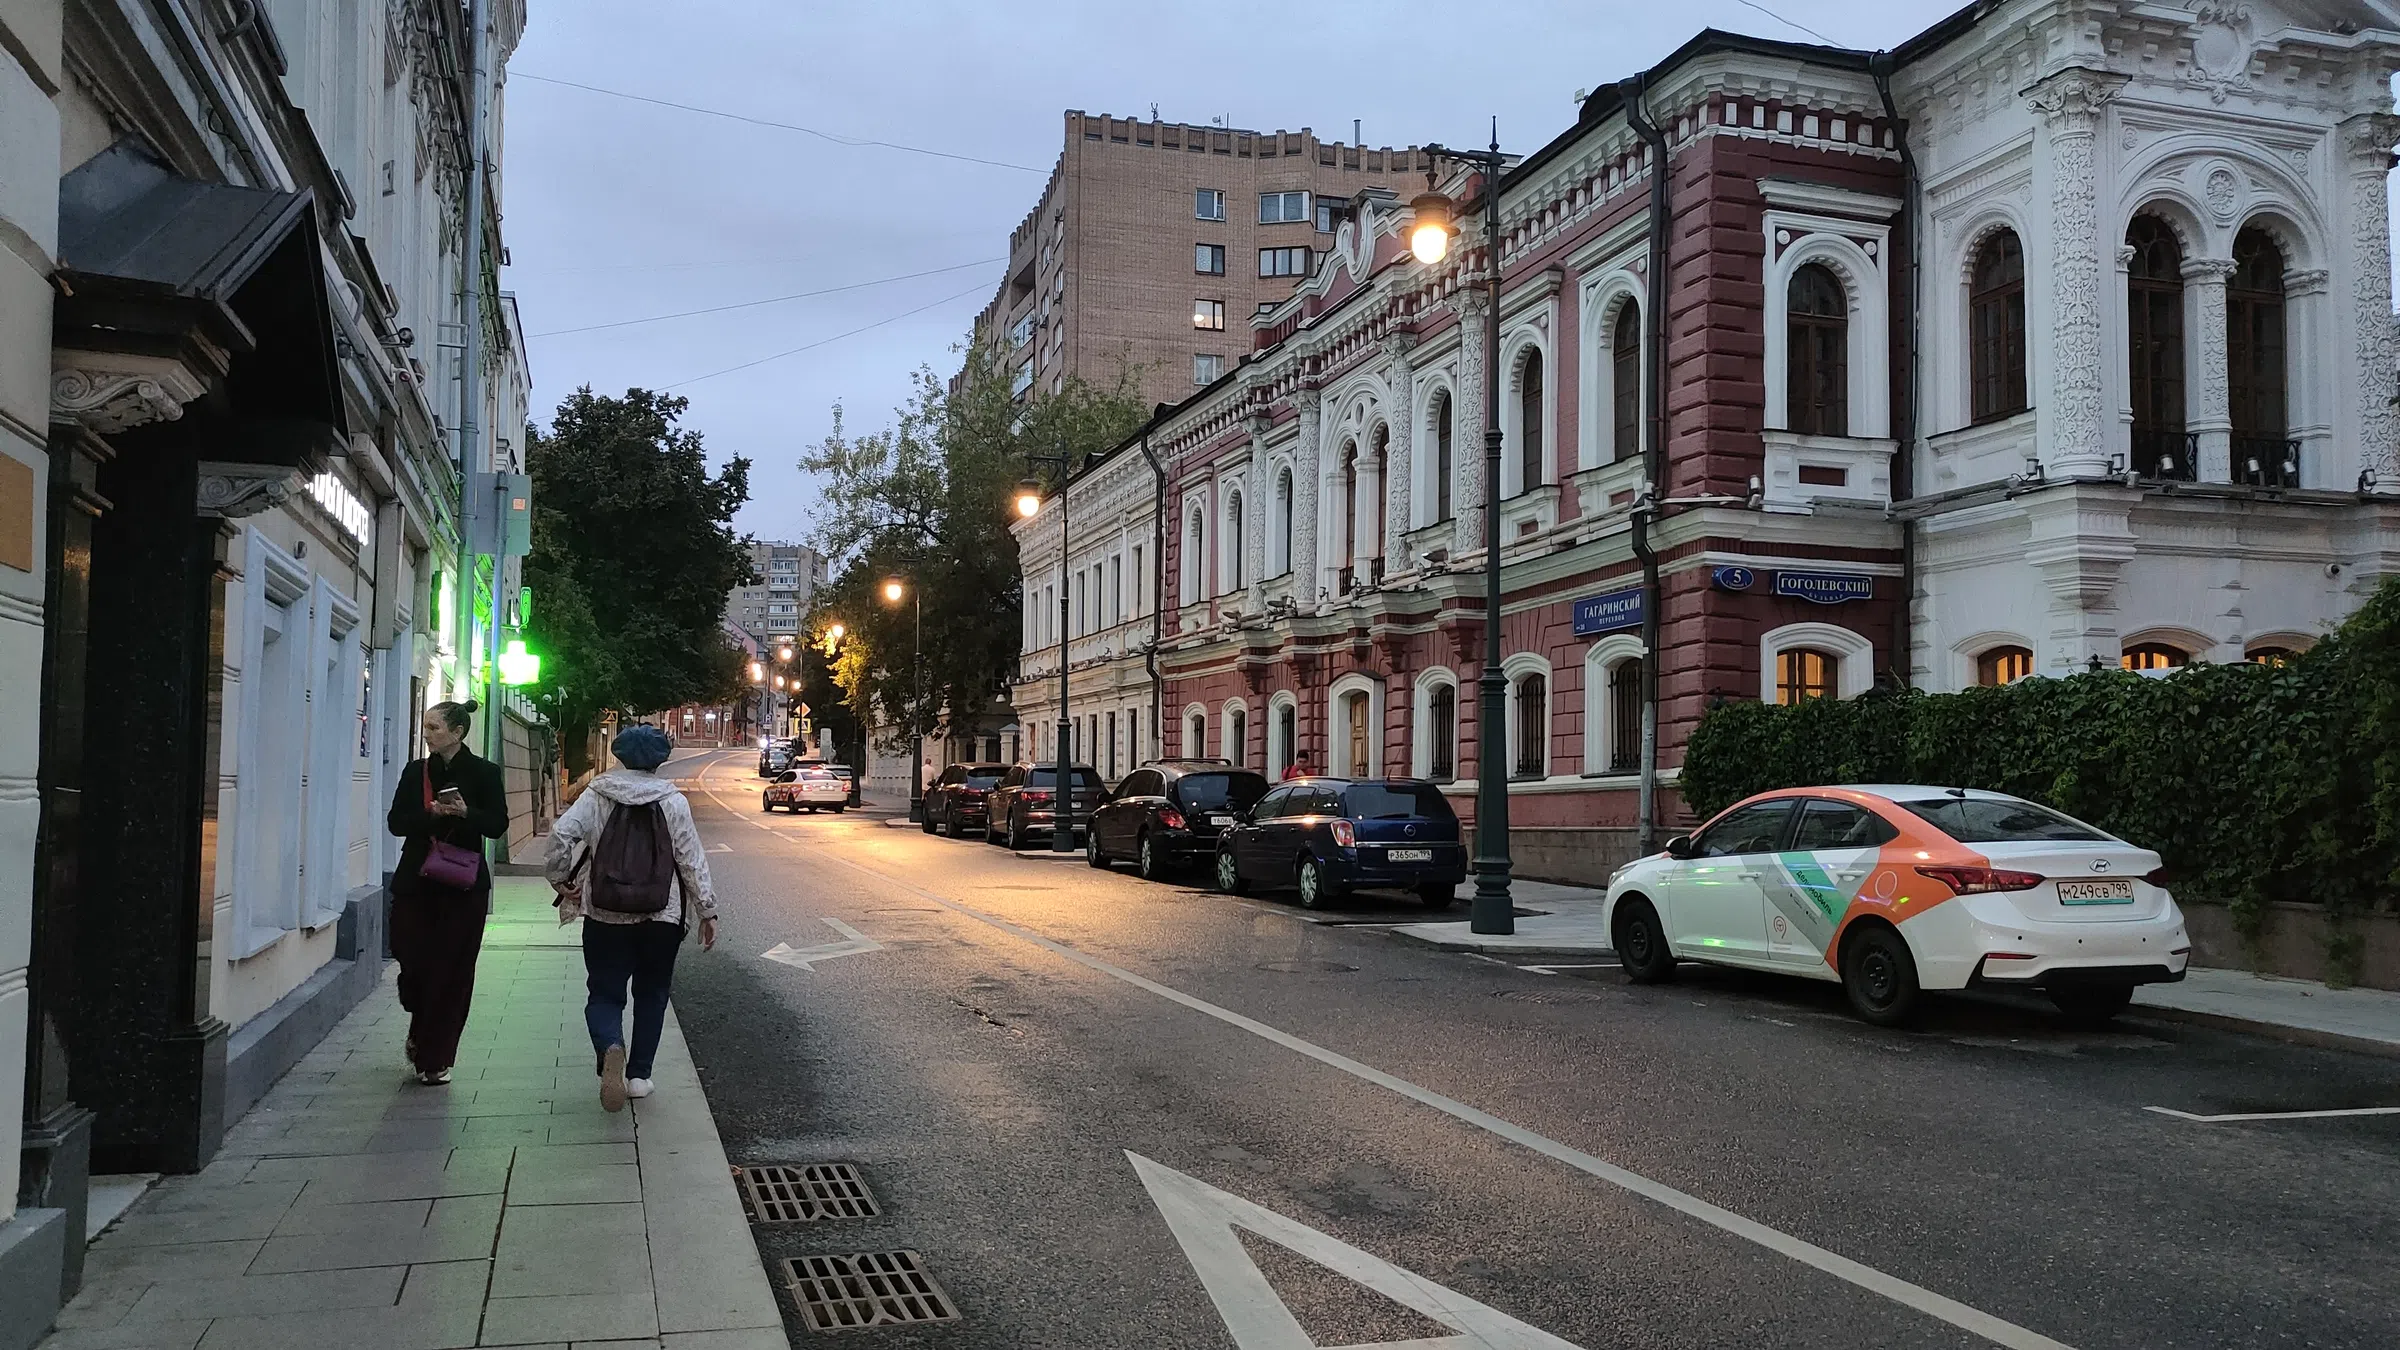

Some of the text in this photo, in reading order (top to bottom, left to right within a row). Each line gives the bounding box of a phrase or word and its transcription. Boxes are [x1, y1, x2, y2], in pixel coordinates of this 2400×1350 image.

[1733, 569, 1742, 584] 5
[1781, 577, 1869, 593] ГОГОЛЕВСКИЙ
[1584, 594, 1640, 619] ГАГАРИНСКИЙ
[1599, 614, 1625, 625] ПЕРЕУЛОК
